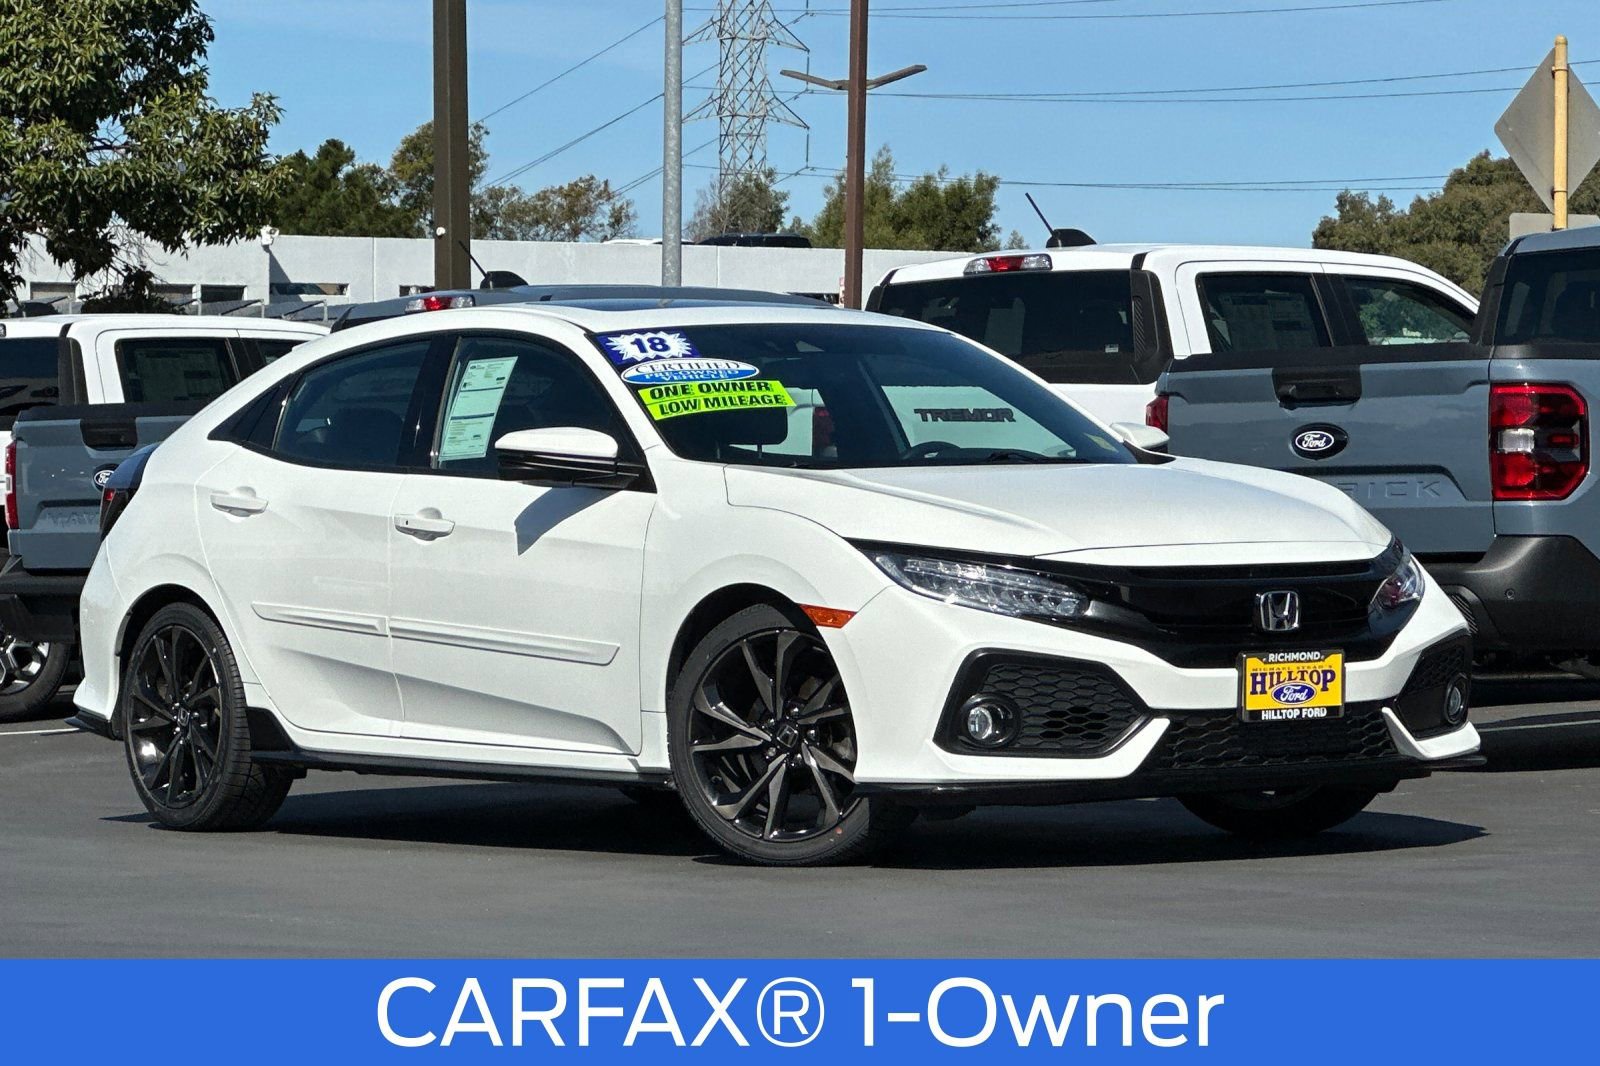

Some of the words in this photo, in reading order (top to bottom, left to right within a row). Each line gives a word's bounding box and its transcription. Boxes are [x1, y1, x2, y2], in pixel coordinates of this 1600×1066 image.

[630, 336, 671, 353] 18
[636, 361, 740, 374] CERTIFIED
[649, 383, 692, 400] ONE
[699, 381, 772, 395] OWNER
[659, 398, 700, 415] LOW
[705, 394, 785, 409] MILEAGE
[913, 408, 1017, 423] TREMOR
[1302, 434, 1327, 448] Ford
[1337, 481, 1441, 499] RICK
[1268, 651, 1321, 663] RICHMOND
[1250, 669, 1336, 695] HILLTOP
[1280, 685, 1309, 702] Ford
[1261, 708, 1300, 720] HILLTOP
[1302, 707, 1328, 718] FORD
